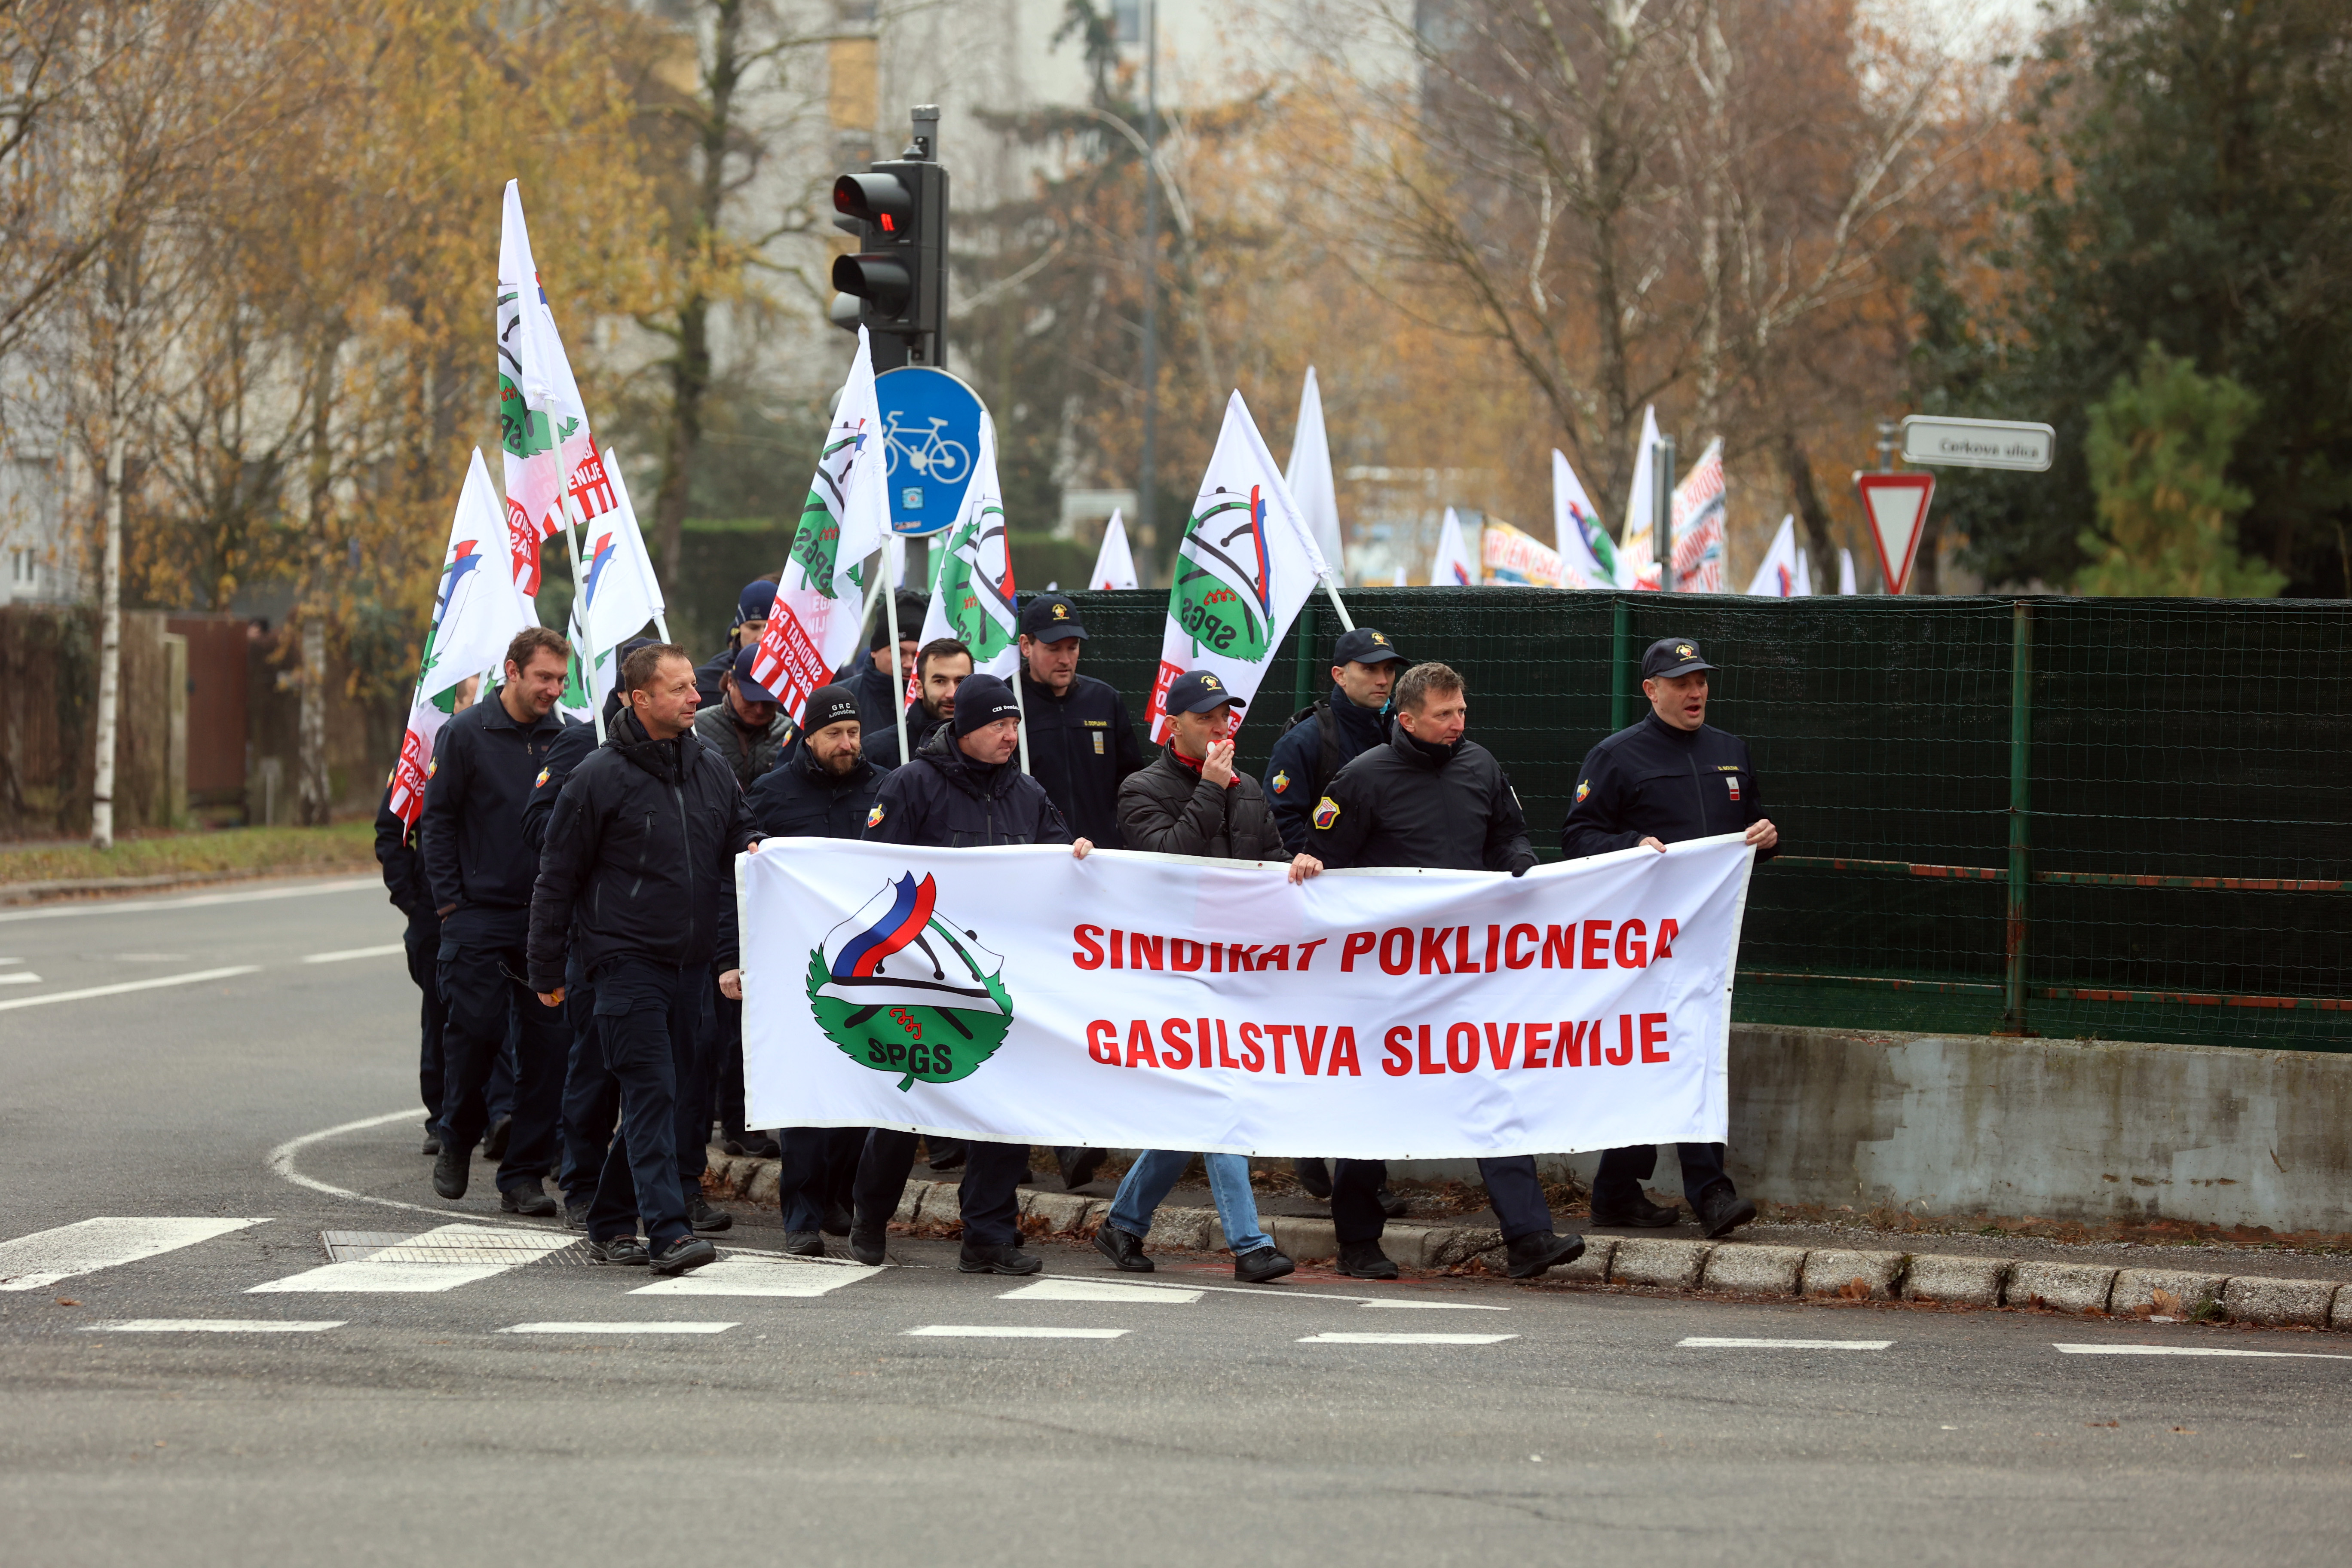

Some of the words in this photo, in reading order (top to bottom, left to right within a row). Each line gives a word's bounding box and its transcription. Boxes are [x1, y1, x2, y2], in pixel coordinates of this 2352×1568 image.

[2005, 442, 2039, 458] ulica
[828, 709, 856, 719] AJDOVŠČINA
[1074, 925, 1326, 972] SINDIKAT
[1341, 919, 1678, 975] POKLICNEGA
[868, 1038, 952, 1075] SPGS
[1087, 1018, 1361, 1076] GASILSTVA
[1383, 1013, 1669, 1076] SLOVENIJE
